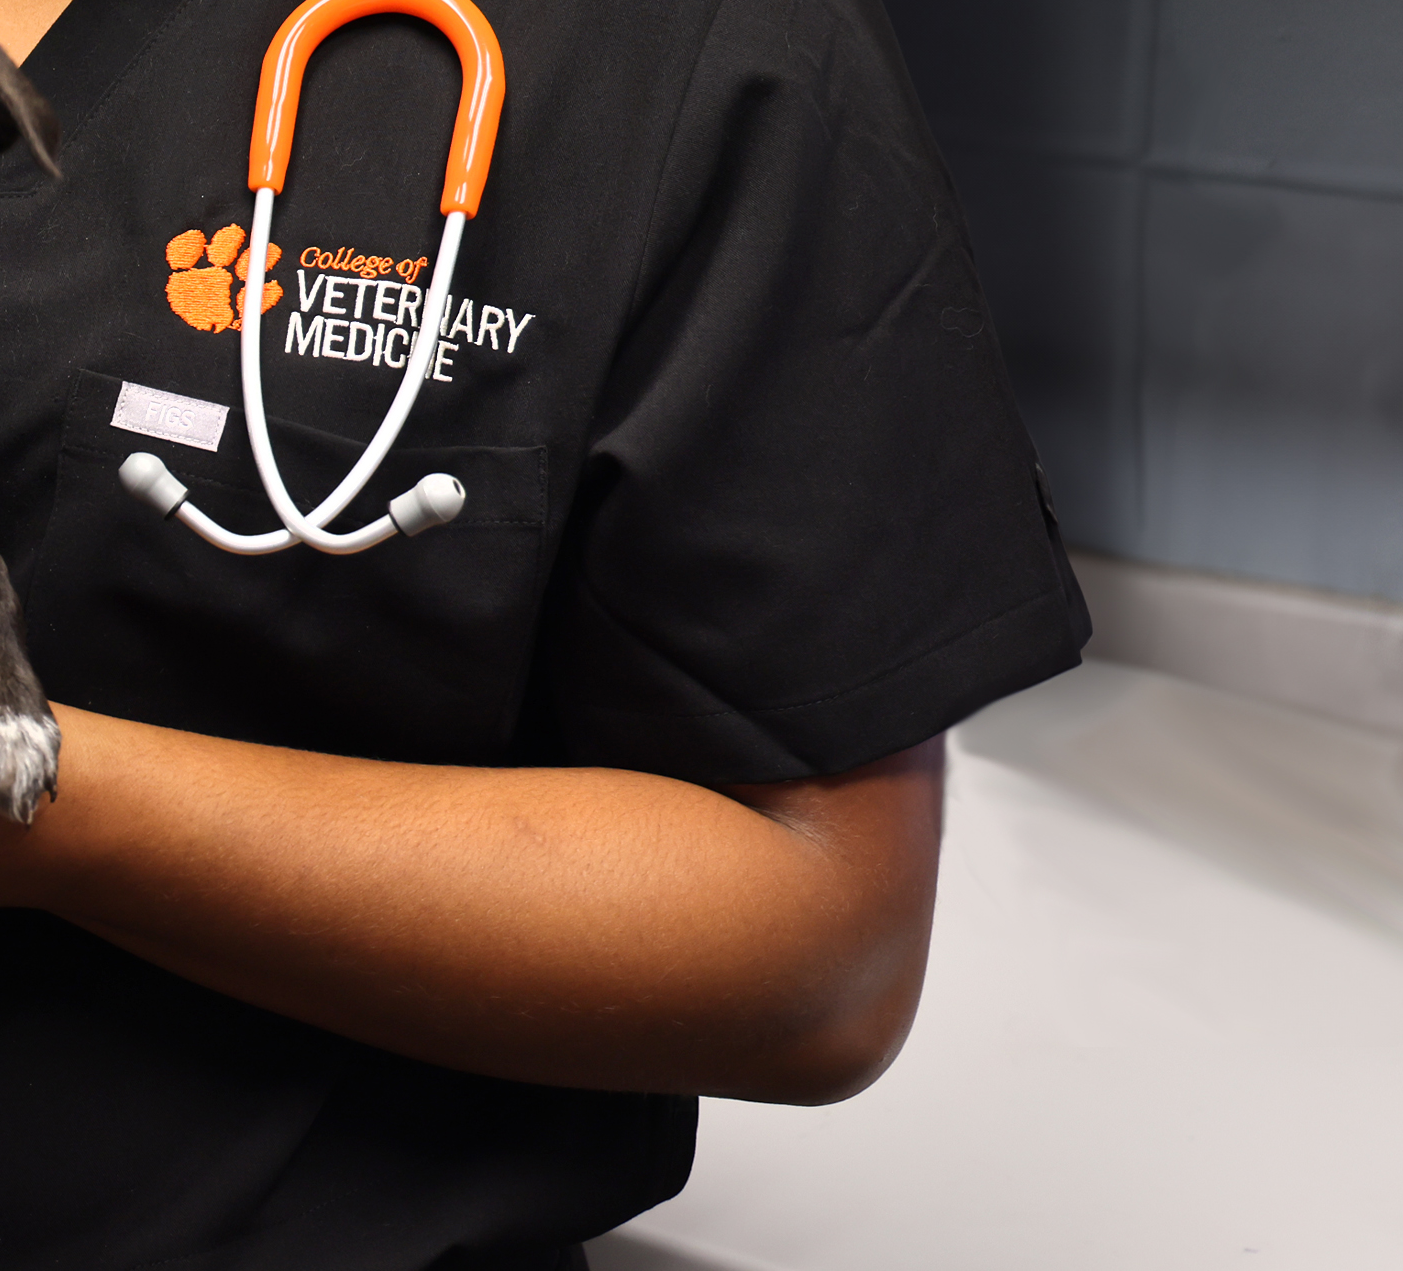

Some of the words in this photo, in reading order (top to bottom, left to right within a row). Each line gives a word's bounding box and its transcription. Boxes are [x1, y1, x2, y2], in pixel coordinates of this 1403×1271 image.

[300, 246, 395, 279] College
[396, 256, 429, 284] of
[145, 401, 196, 430] FIGS
